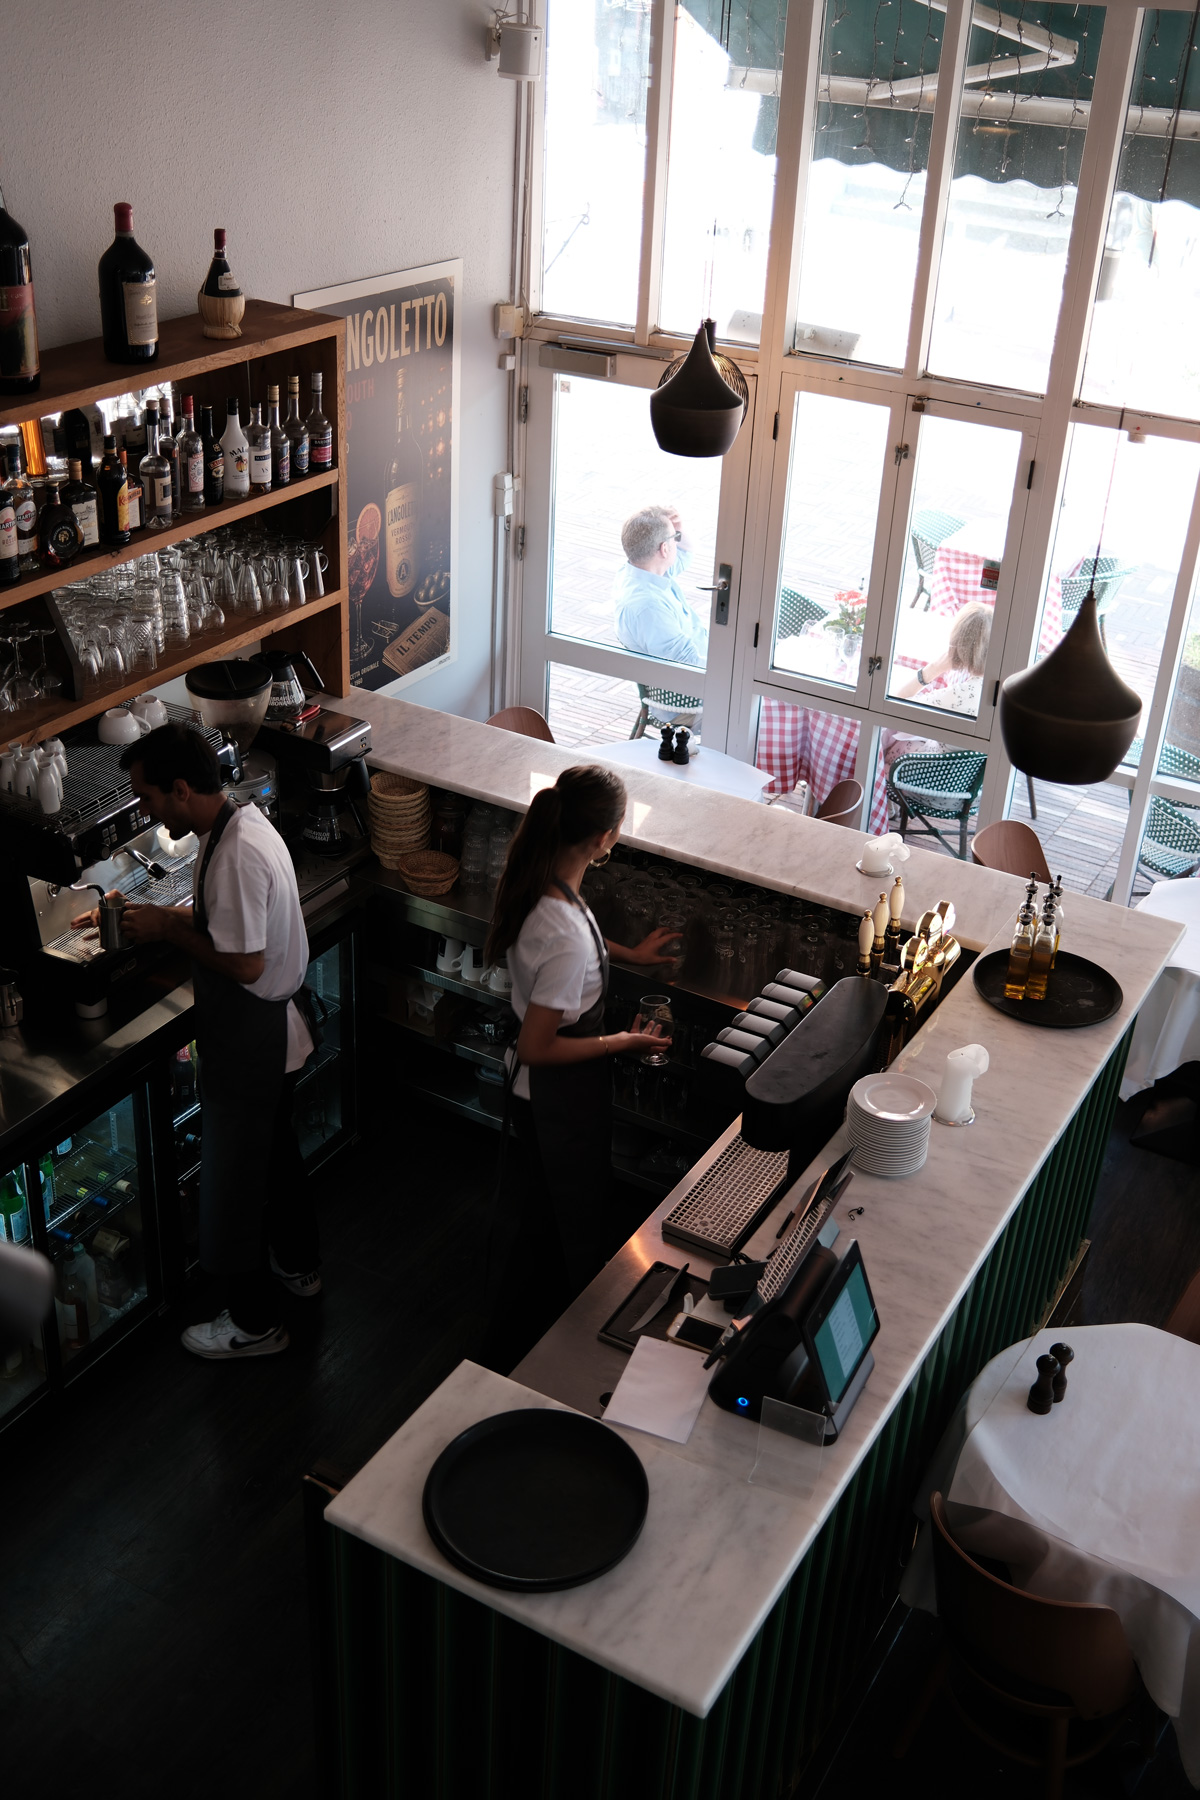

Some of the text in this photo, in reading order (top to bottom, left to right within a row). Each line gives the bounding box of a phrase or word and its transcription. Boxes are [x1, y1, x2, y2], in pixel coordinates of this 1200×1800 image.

[346, 292, 447, 372] NGOLETTO
[347, 377, 375, 404] OUTH
[396, 645, 410, 656] IL
[406, 616, 438, 646] TEMPO
